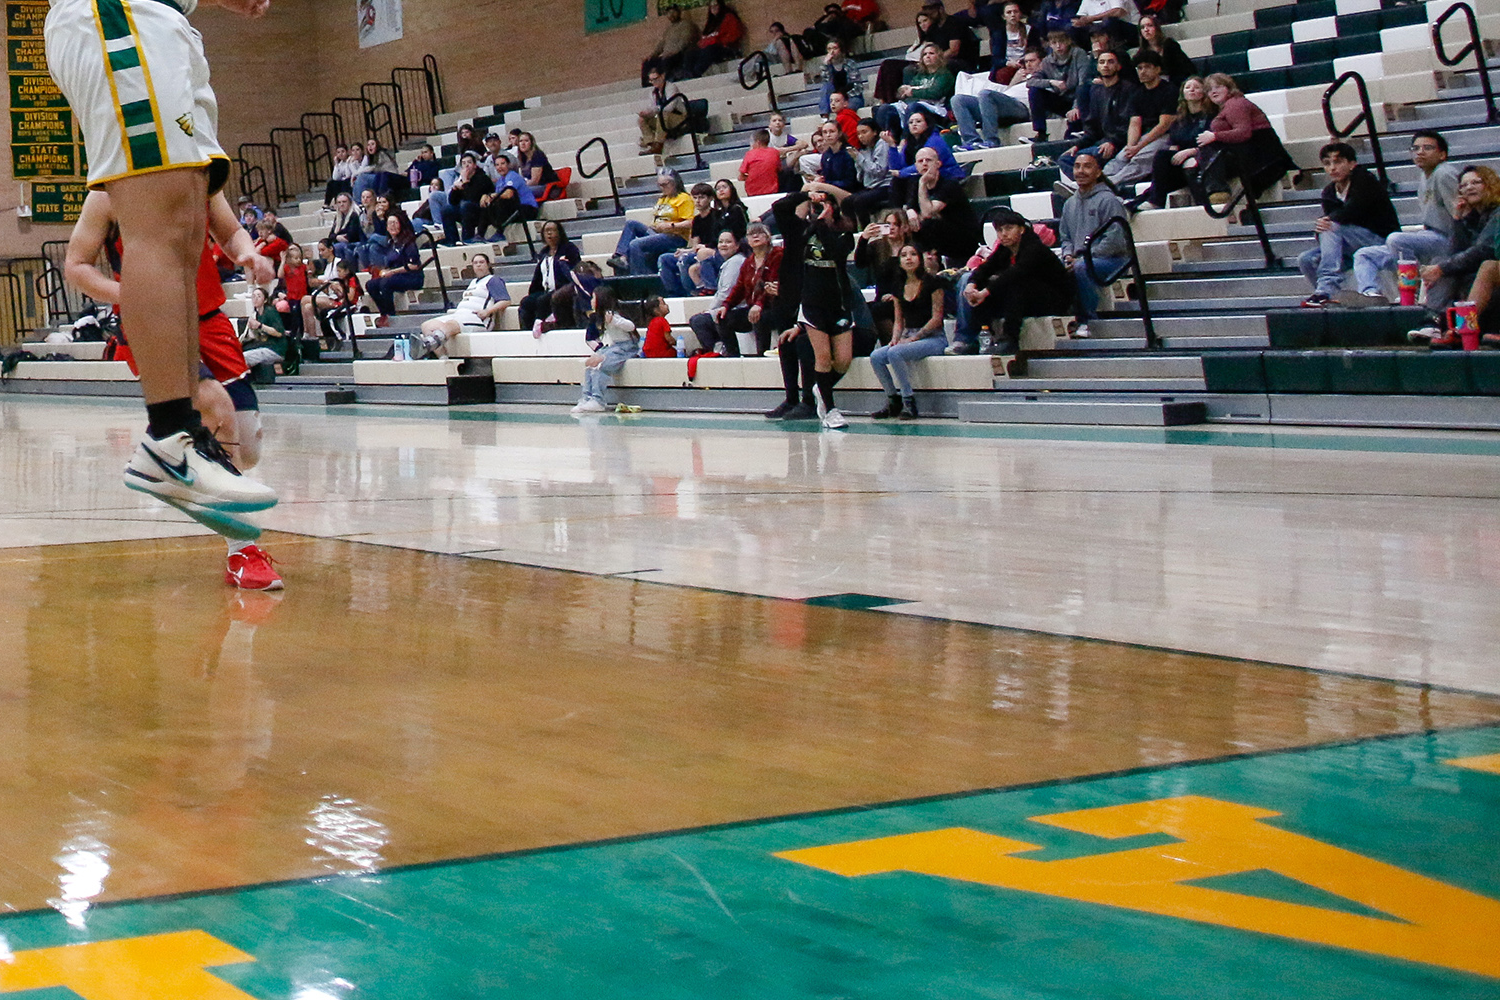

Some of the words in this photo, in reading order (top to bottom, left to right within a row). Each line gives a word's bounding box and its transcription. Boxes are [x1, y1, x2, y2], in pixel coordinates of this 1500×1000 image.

[24, 112, 59, 121] DIVISION
[18, 121, 65, 130] CHAMPIONS
[30, 146, 58, 154] STATE
[20, 155, 68, 163] CHAMPIONS
[36, 185, 56, 193] BOYS
[63, 193, 74, 202] 4A
[36, 204, 59, 213] STATE
